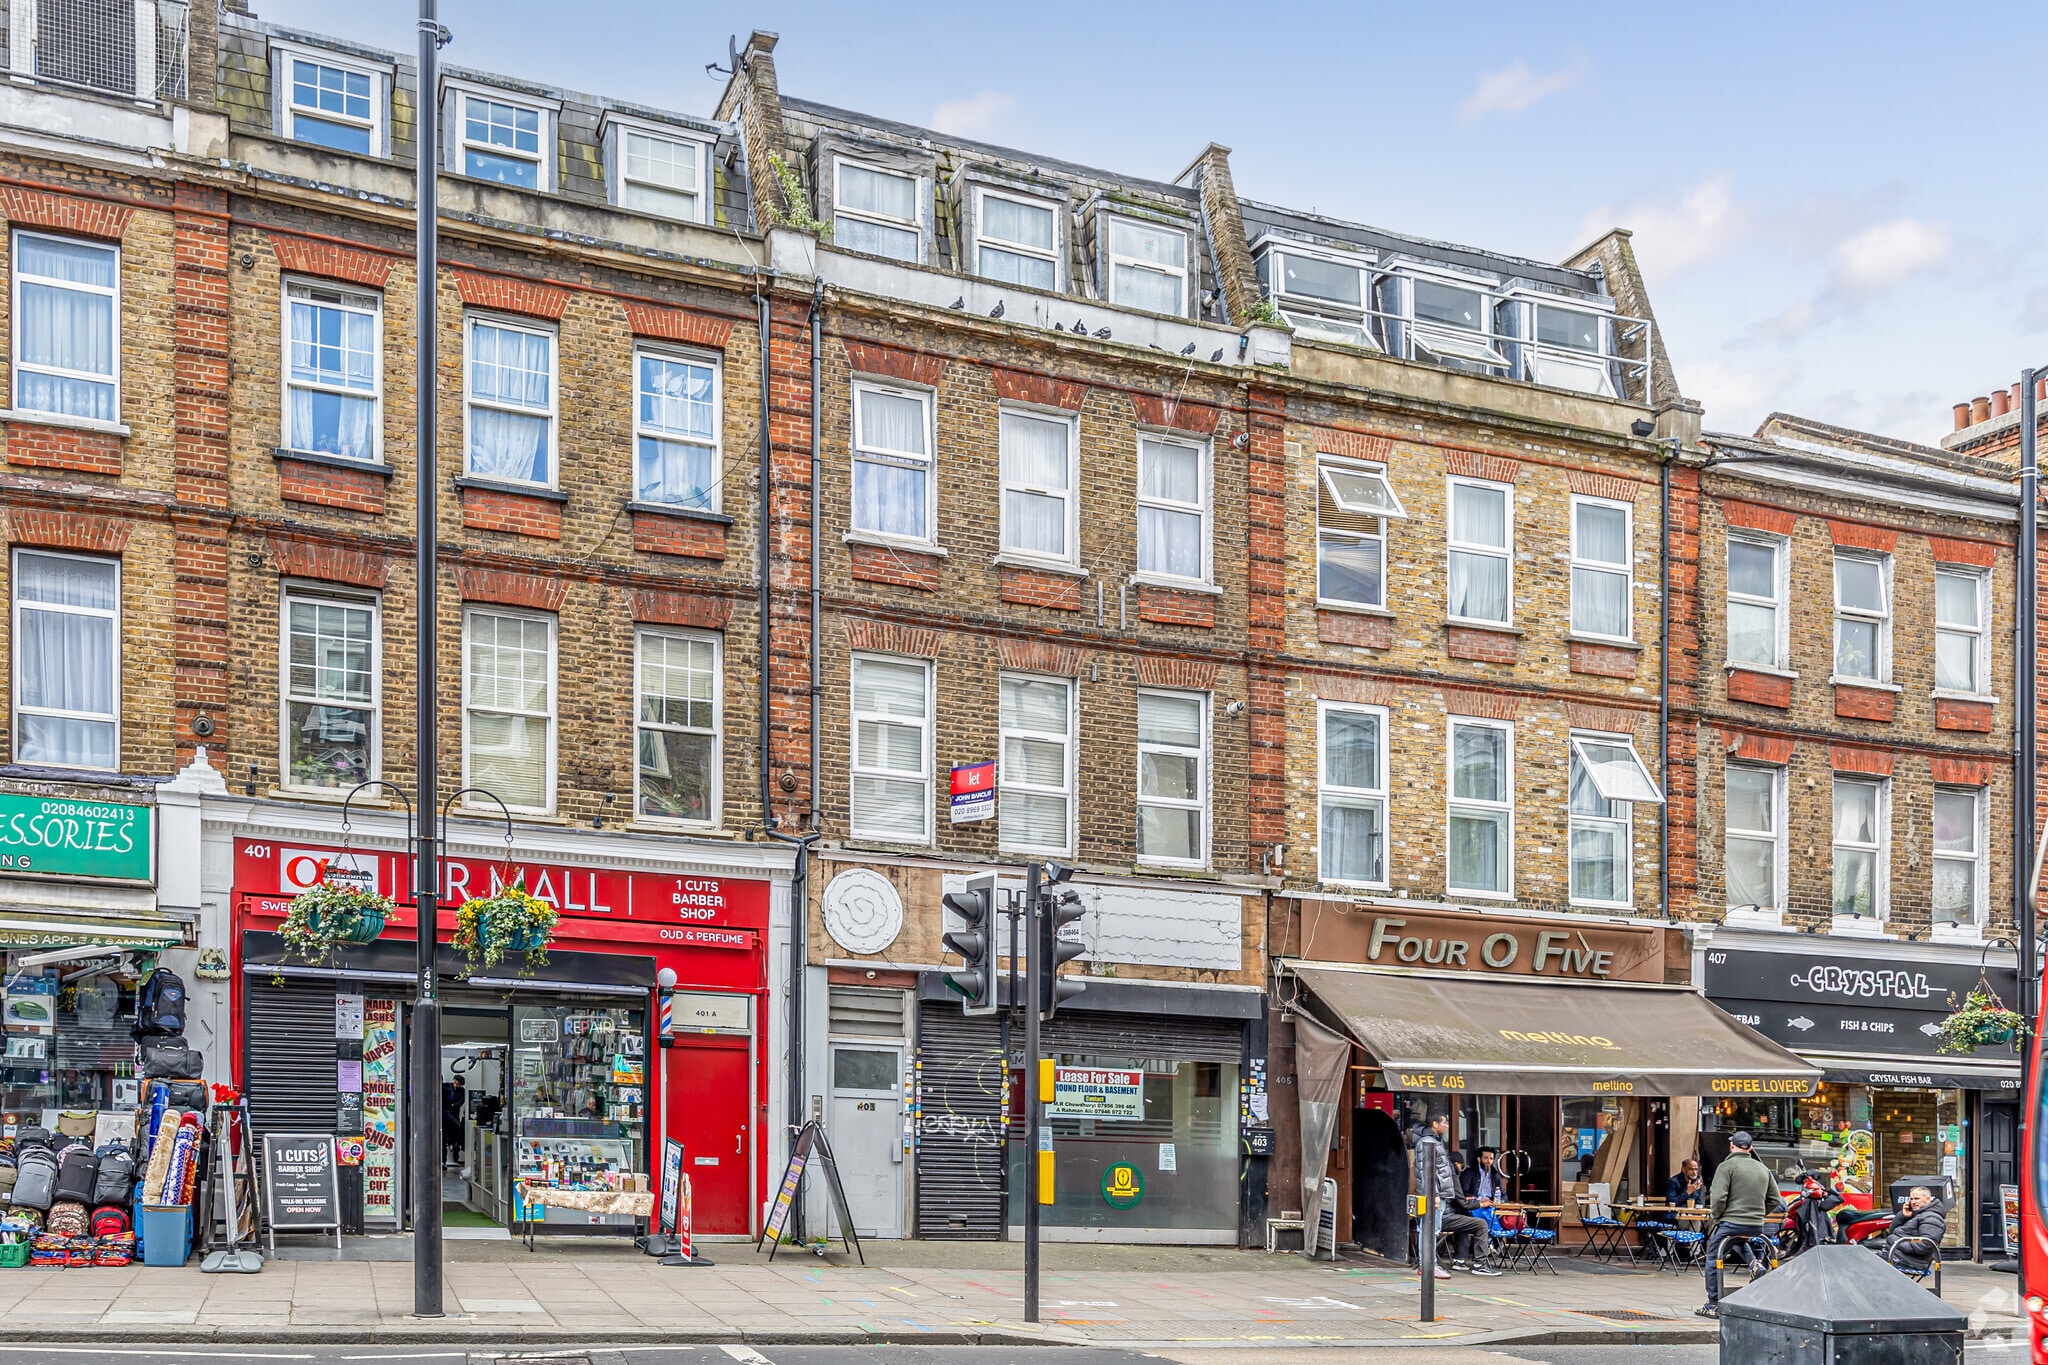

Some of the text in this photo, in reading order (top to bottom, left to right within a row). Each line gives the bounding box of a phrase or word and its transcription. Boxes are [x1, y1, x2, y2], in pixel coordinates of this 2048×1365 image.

[968, 771, 980, 786] let
[955, 794, 971, 802] JOHN
[970, 789, 993, 800] BARCLAY
[41, 802, 135, 821] 02084602413
[244, 844, 271, 859] 401
[490, 864, 611, 912] MALL
[676, 880, 719, 893] 1 CUTS
[672, 893, 723, 907] BARBER
[680, 907, 715, 920] SHOP
[660, 930, 744, 944] OUD & PERFUME
[1481, 933, 1518, 968] O
[1708, 953, 1728, 965] 407
[1808, 966, 1929, 998] CRYSTAL
[366, 999, 393, 1011] NAILS
[523, 1027, 555, 1037] OPEN
[564, 1020, 612, 1035] REPAIR
[1840, 1020, 1894, 1033] FISH & CHIPS
[1499, 1029, 1614, 1047] meltino
[363, 1041, 395, 1064] VAPES
[1059, 1070, 1130, 1085] Lease For Sale
[1275, 1076, 1292, 1085] 405
[1401, 1072, 1466, 1089] CAFÉ 405
[1869, 1074, 1933, 1085] CRYSTAL FISH BAR
[363, 1082, 396, 1094] SMOKE
[1078, 1085, 1098, 1094] FLOOR
[1105, 1086, 1138, 1095] BASEMENT
[1593, 1080, 1634, 1091] meltino
[1711, 1079, 1809, 1093] COFFEE LOVERS
[2000, 1080, 2014, 1089] 020
[366, 1096, 393, 1108] SHOP
[364, 1127, 395, 1150] SNUS
[1252, 1138, 1267, 1147] 403
[275, 1149, 319, 1162] 1 CUTS
[366, 1167, 391, 1177] KEYS
[369, 1180, 389, 1191] CUT
[366, 1194, 391, 1205] HERE
